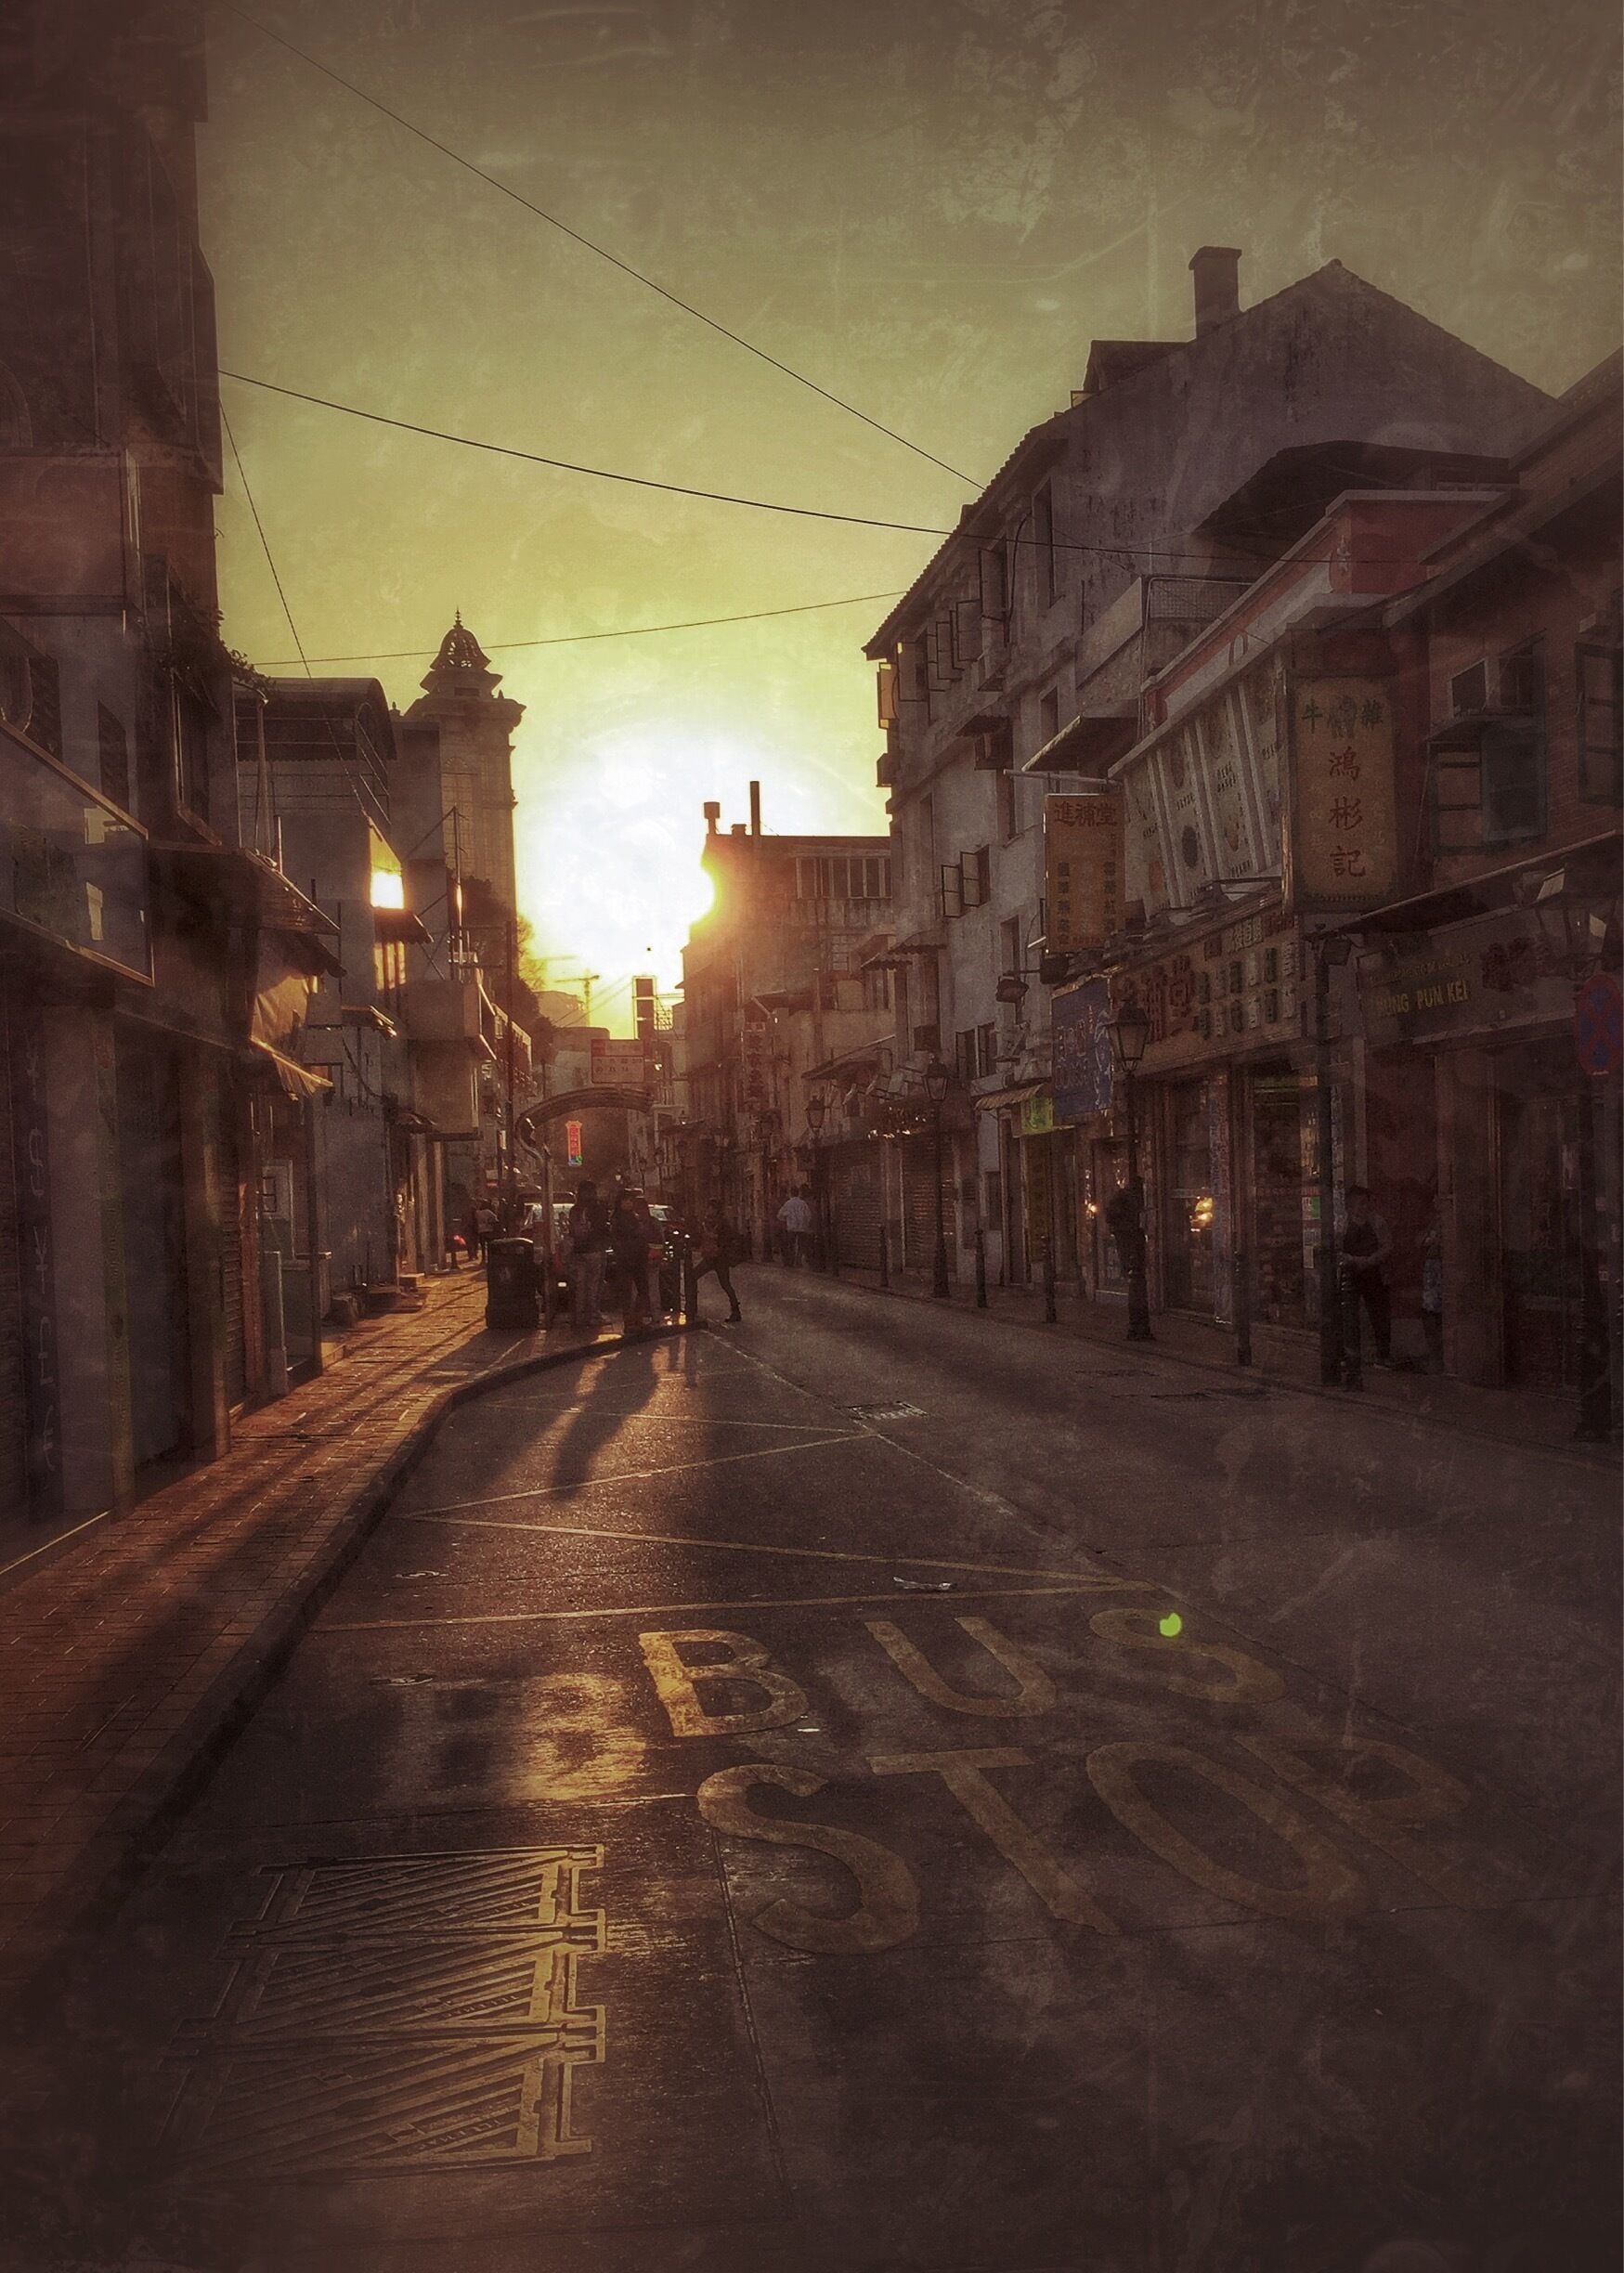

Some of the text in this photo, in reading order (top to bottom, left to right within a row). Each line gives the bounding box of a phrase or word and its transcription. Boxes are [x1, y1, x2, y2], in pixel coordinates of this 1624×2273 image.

[1328, 746, 1366, 877] 鴻彬記
[1416, 985, 1445, 1010] PUN
[1446, 979, 1469, 1005] KEI
[638, 1607, 1287, 1737] BUS
[697, 1735, 1478, 1955] STOP
